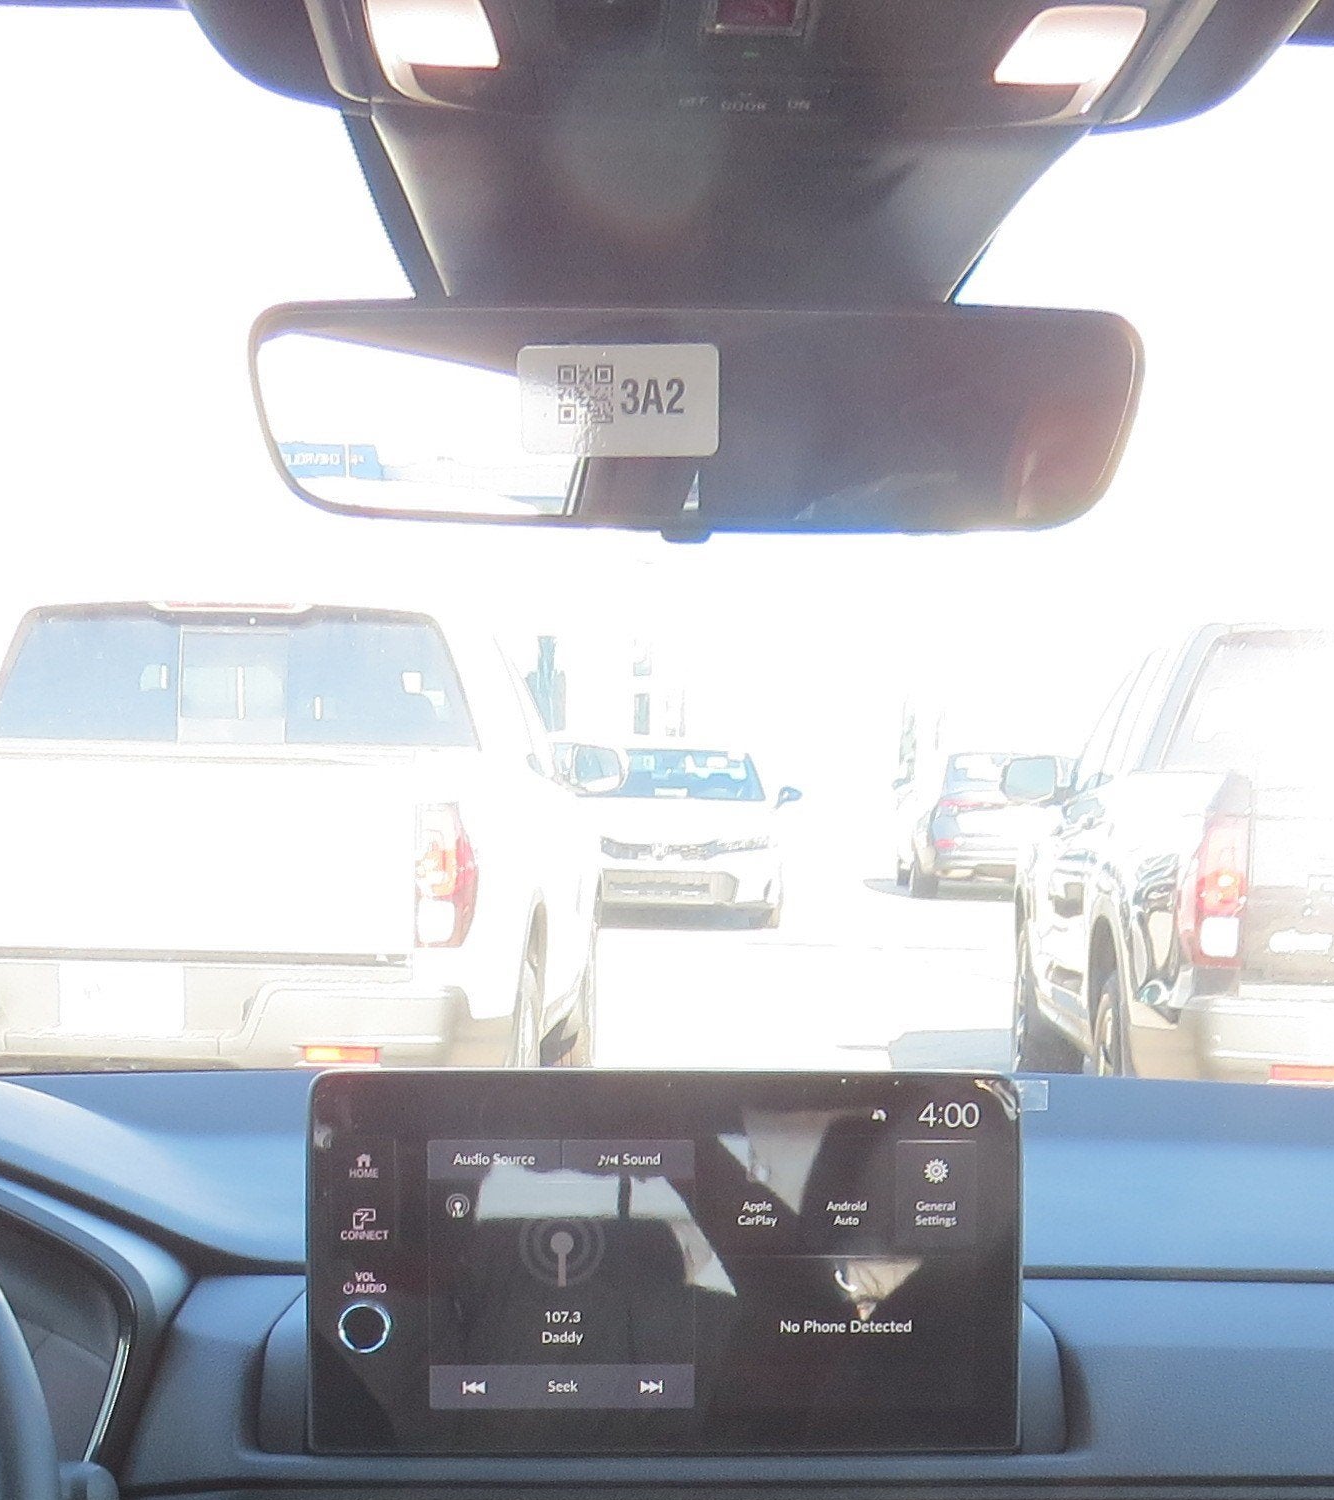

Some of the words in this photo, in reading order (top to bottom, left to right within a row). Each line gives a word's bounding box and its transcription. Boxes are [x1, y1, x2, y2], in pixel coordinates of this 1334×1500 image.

[620, 377, 686, 416] 3A2
[917, 1102, 980, 1129] 4:00
[452, 1153, 490, 1166] Audio
[492, 1153, 536, 1166] Source
[622, 1153, 661, 1166] Sound
[349, 1168, 380, 1179] HOME
[742, 1201, 772, 1214] Apple
[826, 1200, 868, 1212] Android
[916, 1201, 956, 1212] General
[737, 1215, 778, 1227] CarPlay
[833, 1215, 860, 1226] Auto
[915, 1215, 958, 1227] Settings
[340, 1230, 389, 1241] CONNECT
[355, 1272, 376, 1282] VOL
[355, 1283, 387, 1294] AUDIO
[545, 1311, 582, 1323] 107.3
[779, 1320, 800, 1334] No
[803, 1320, 846, 1334] Phone
[850, 1320, 913, 1333] Detected
[542, 1331, 584, 1345] Daddy
[548, 1380, 578, 1393] Seek
